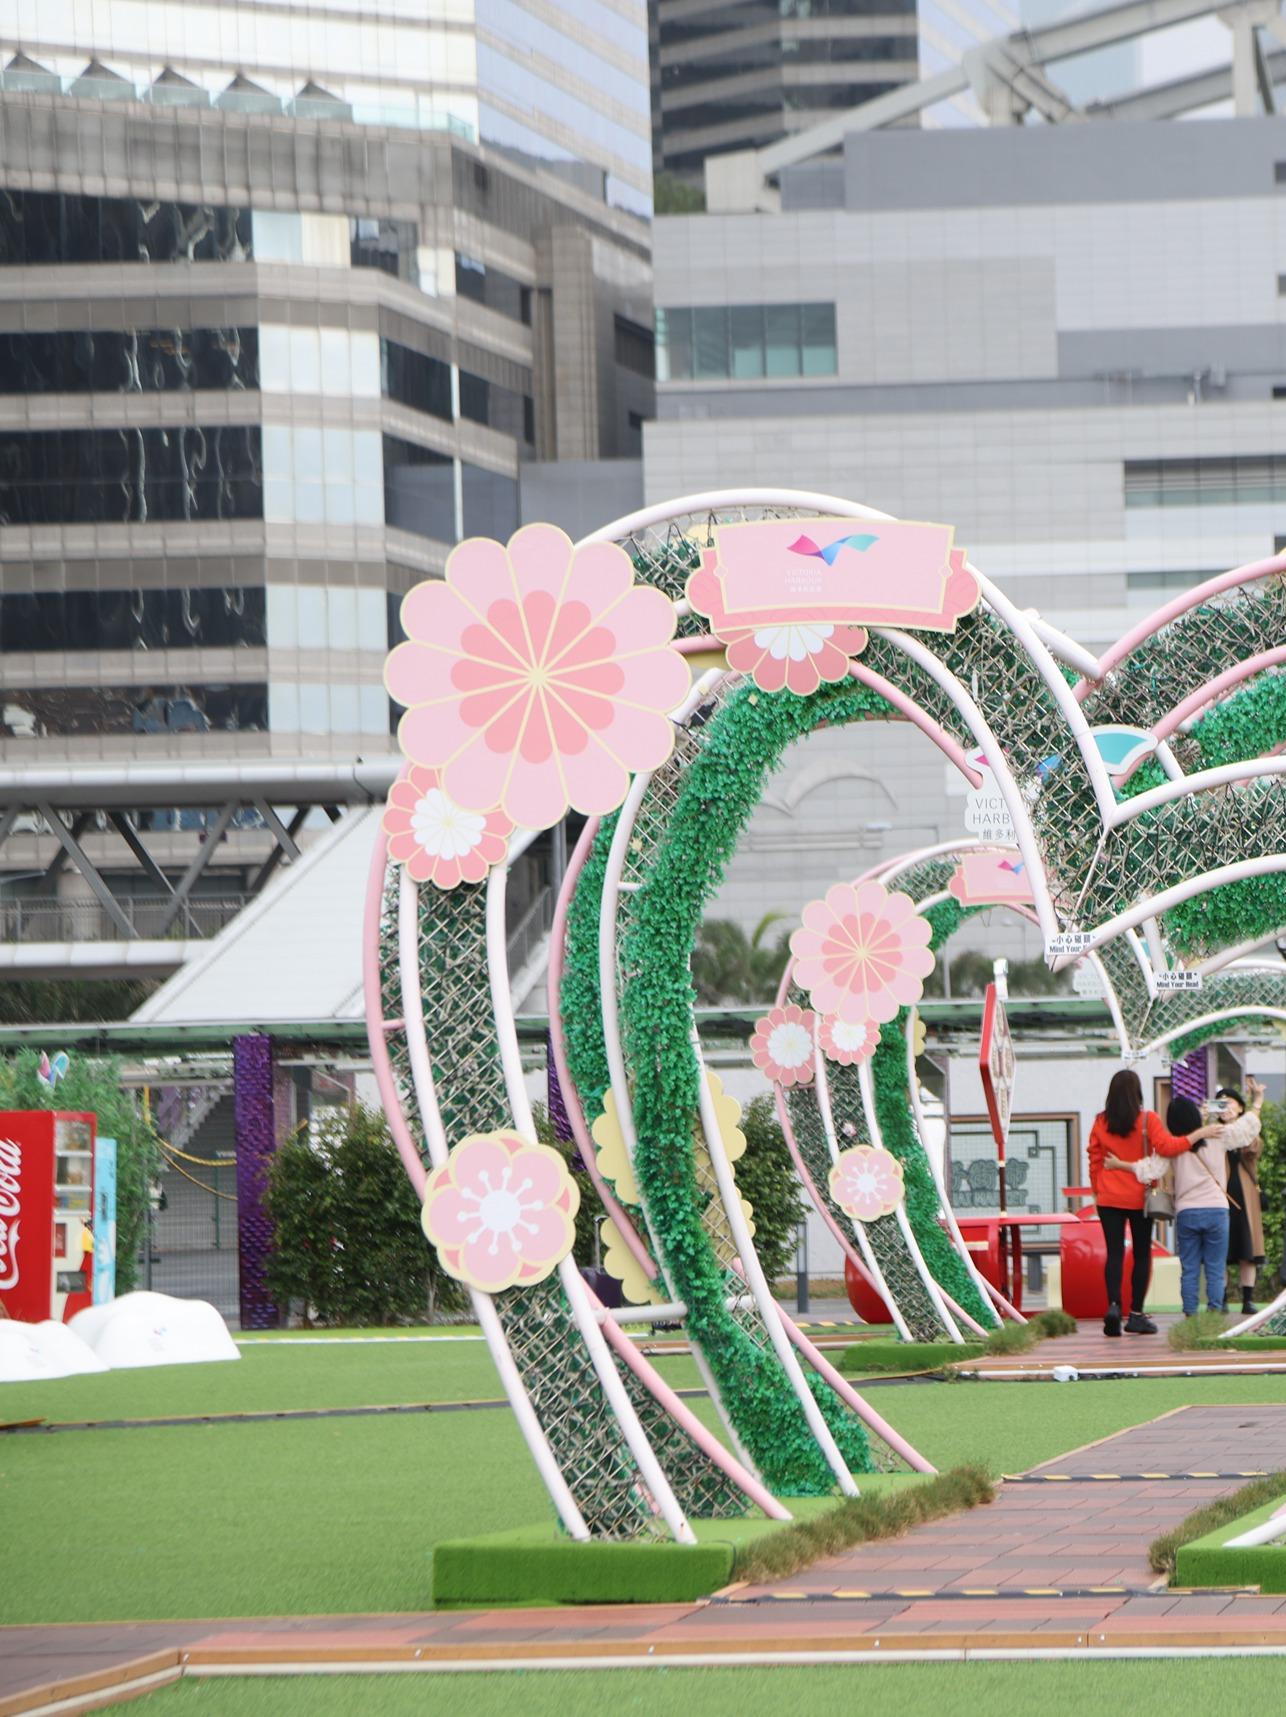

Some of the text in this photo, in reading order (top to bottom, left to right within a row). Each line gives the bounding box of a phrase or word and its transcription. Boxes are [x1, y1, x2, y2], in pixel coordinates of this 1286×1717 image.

[975, 797, 1006, 809] VICT
[972, 812, 1011, 825] HARB
[982, 828, 1017, 841] 維多利
[1049, 945, 1065, 953] Mind
[1066, 945, 1082, 953] Your
[1156, 980, 1170, 988] Mind
[1170, 980, 1185, 988] Your
